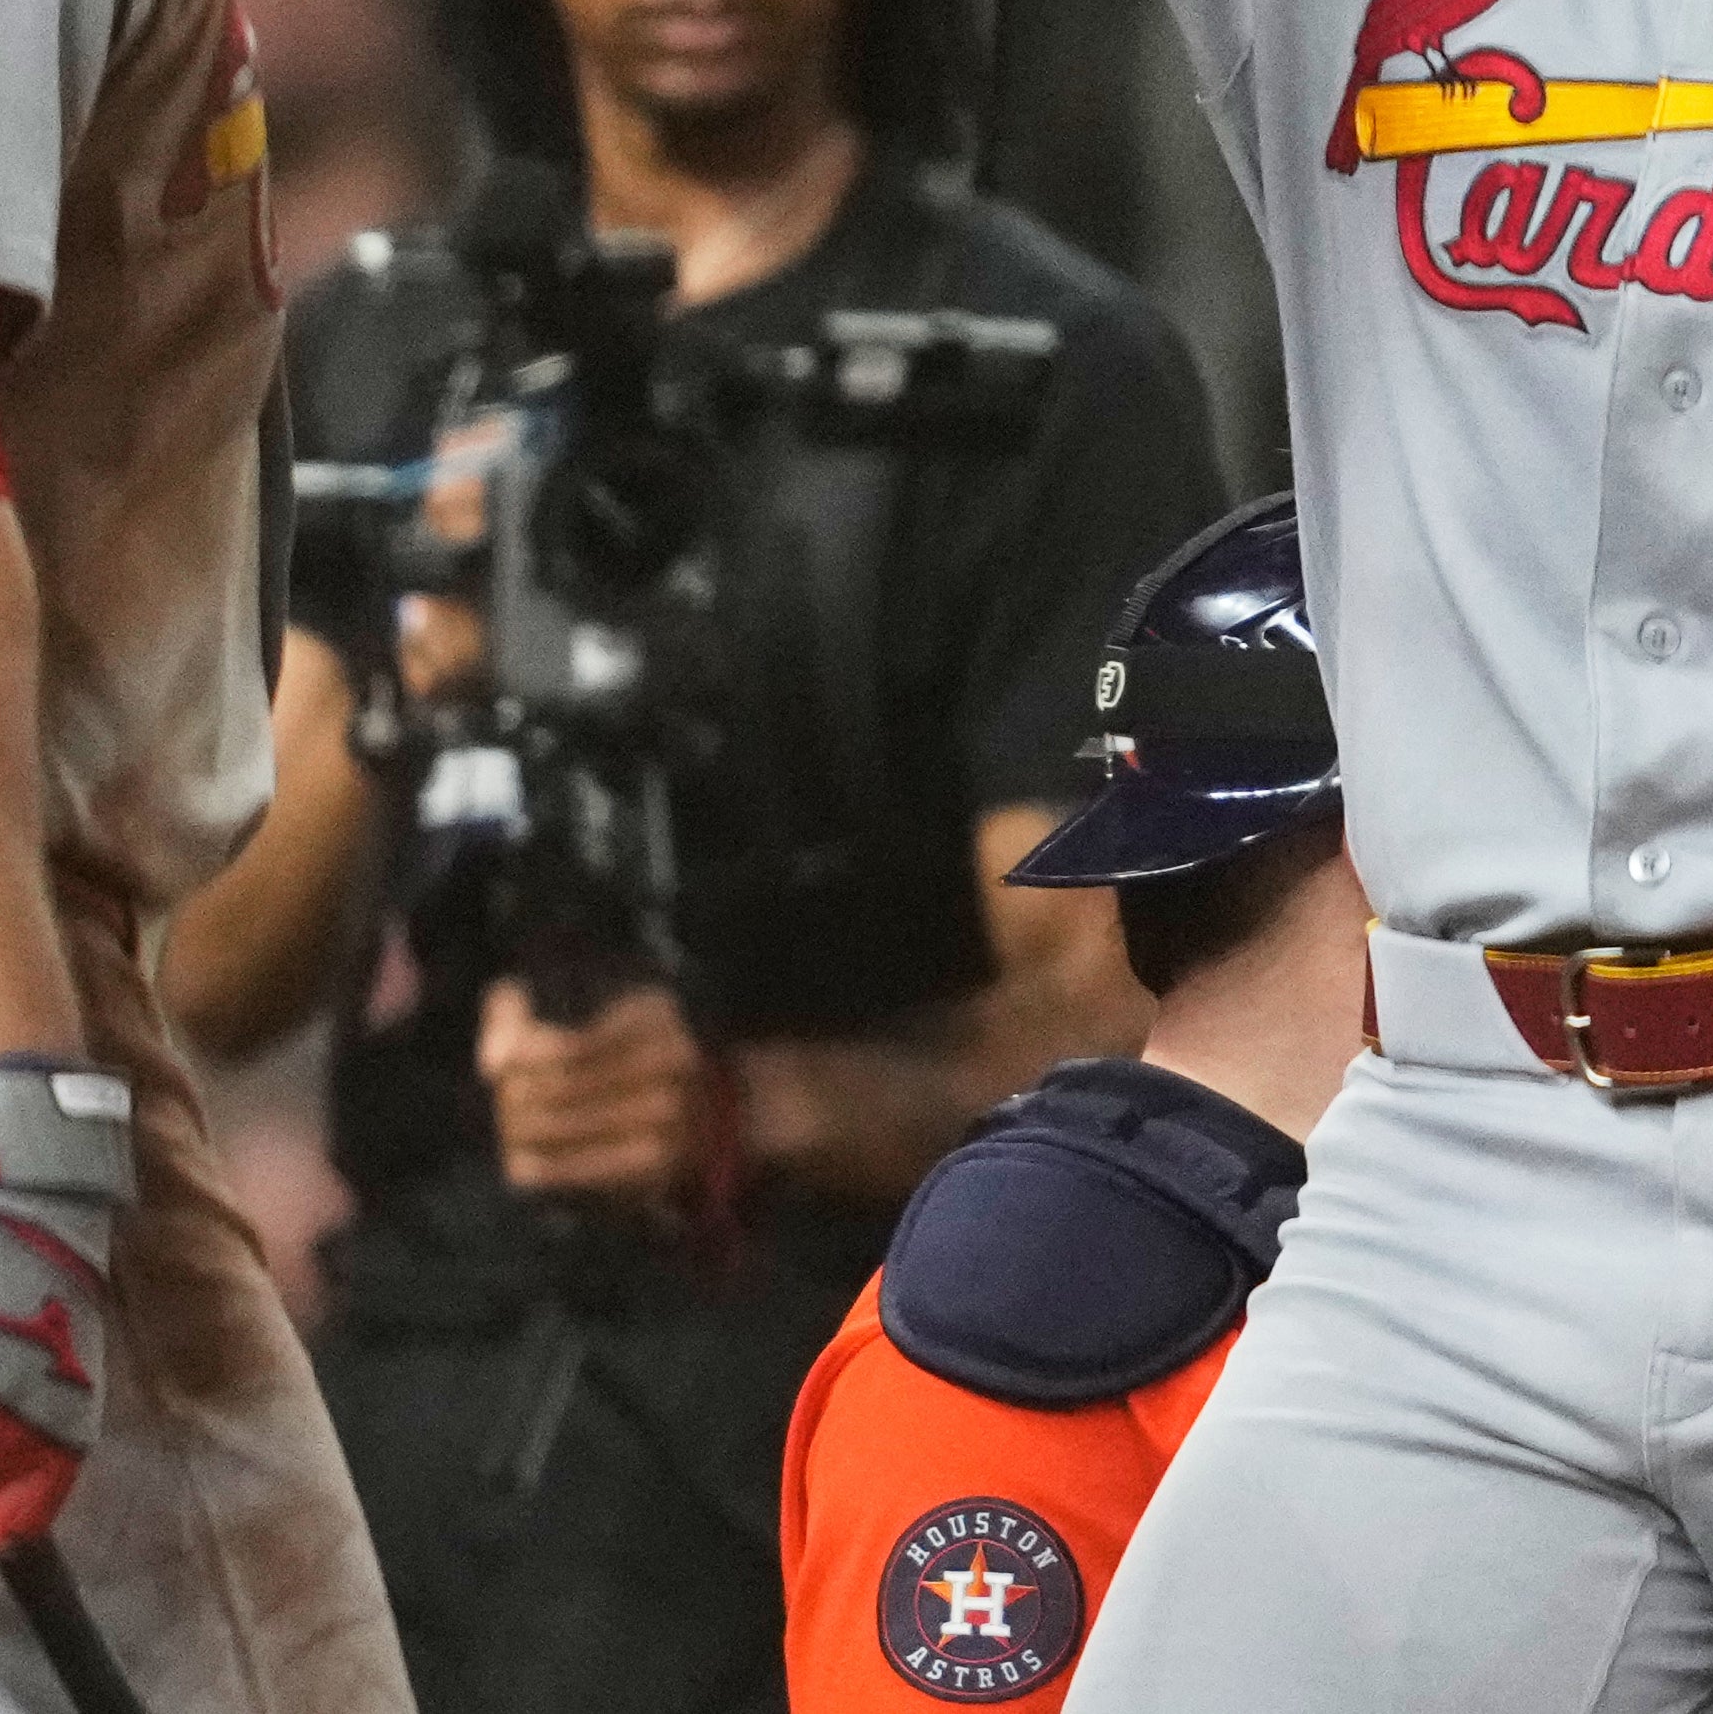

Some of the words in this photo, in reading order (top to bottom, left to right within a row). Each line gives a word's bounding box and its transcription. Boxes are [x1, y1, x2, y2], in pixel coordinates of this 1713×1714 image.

[906, 1512, 1059, 1569] HOUSTON
[939, 1570, 1015, 1637] H
[906, 1646, 1043, 1688] ASTROS
